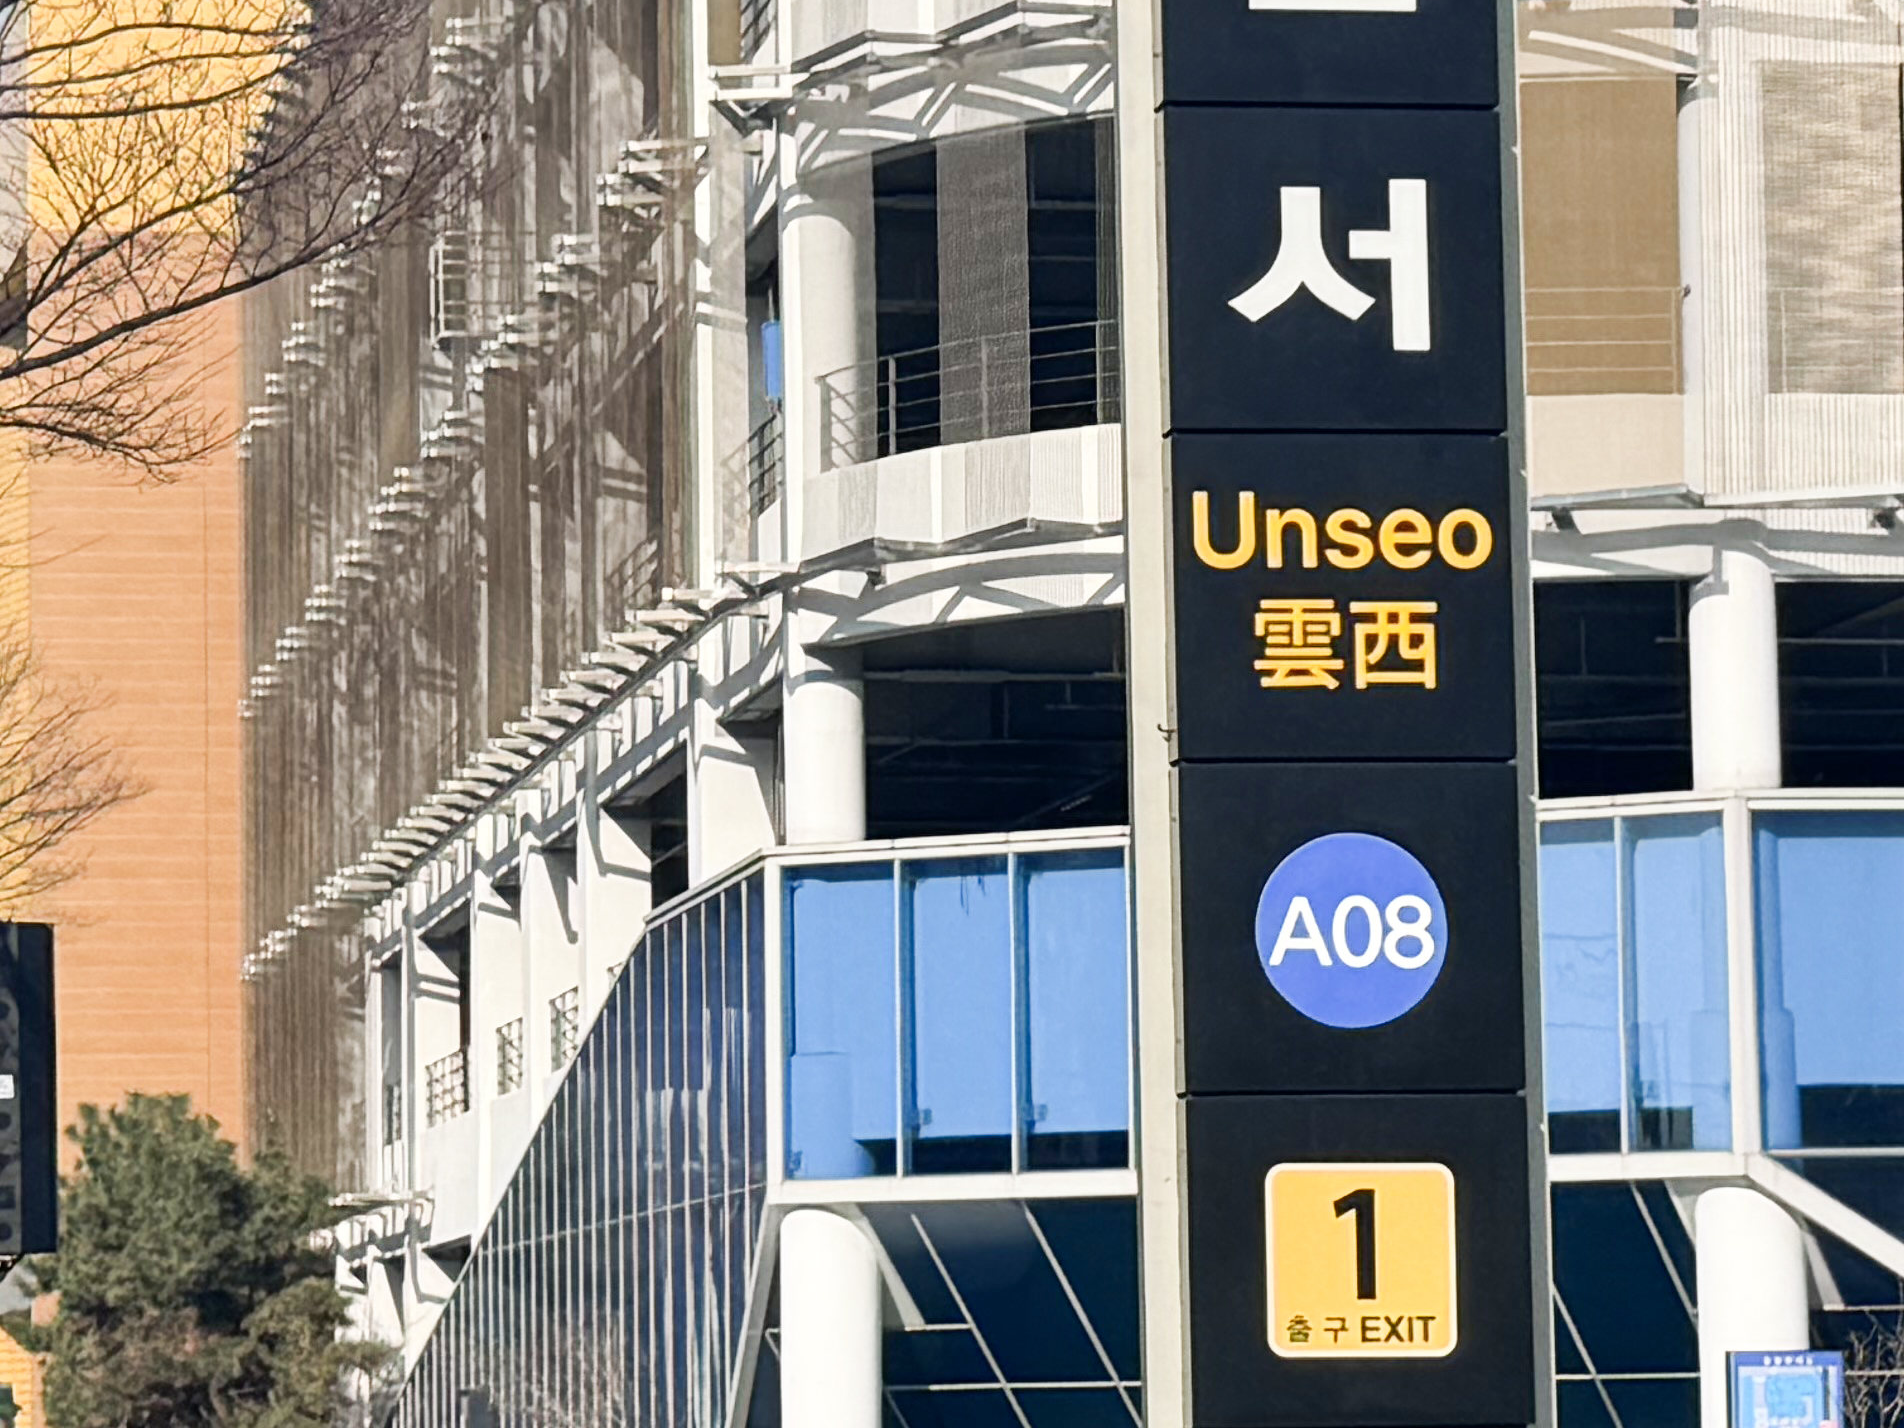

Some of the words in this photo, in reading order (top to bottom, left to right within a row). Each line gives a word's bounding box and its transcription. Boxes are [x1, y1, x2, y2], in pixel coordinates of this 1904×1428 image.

[1192, 490, 1493, 570] Unseo
[1253, 598, 1438, 690] 雲西
[1268, 894, 1435, 970] A08
[1333, 1189, 1377, 1300] 1
[1361, 1315, 1437, 1343] EXIT
